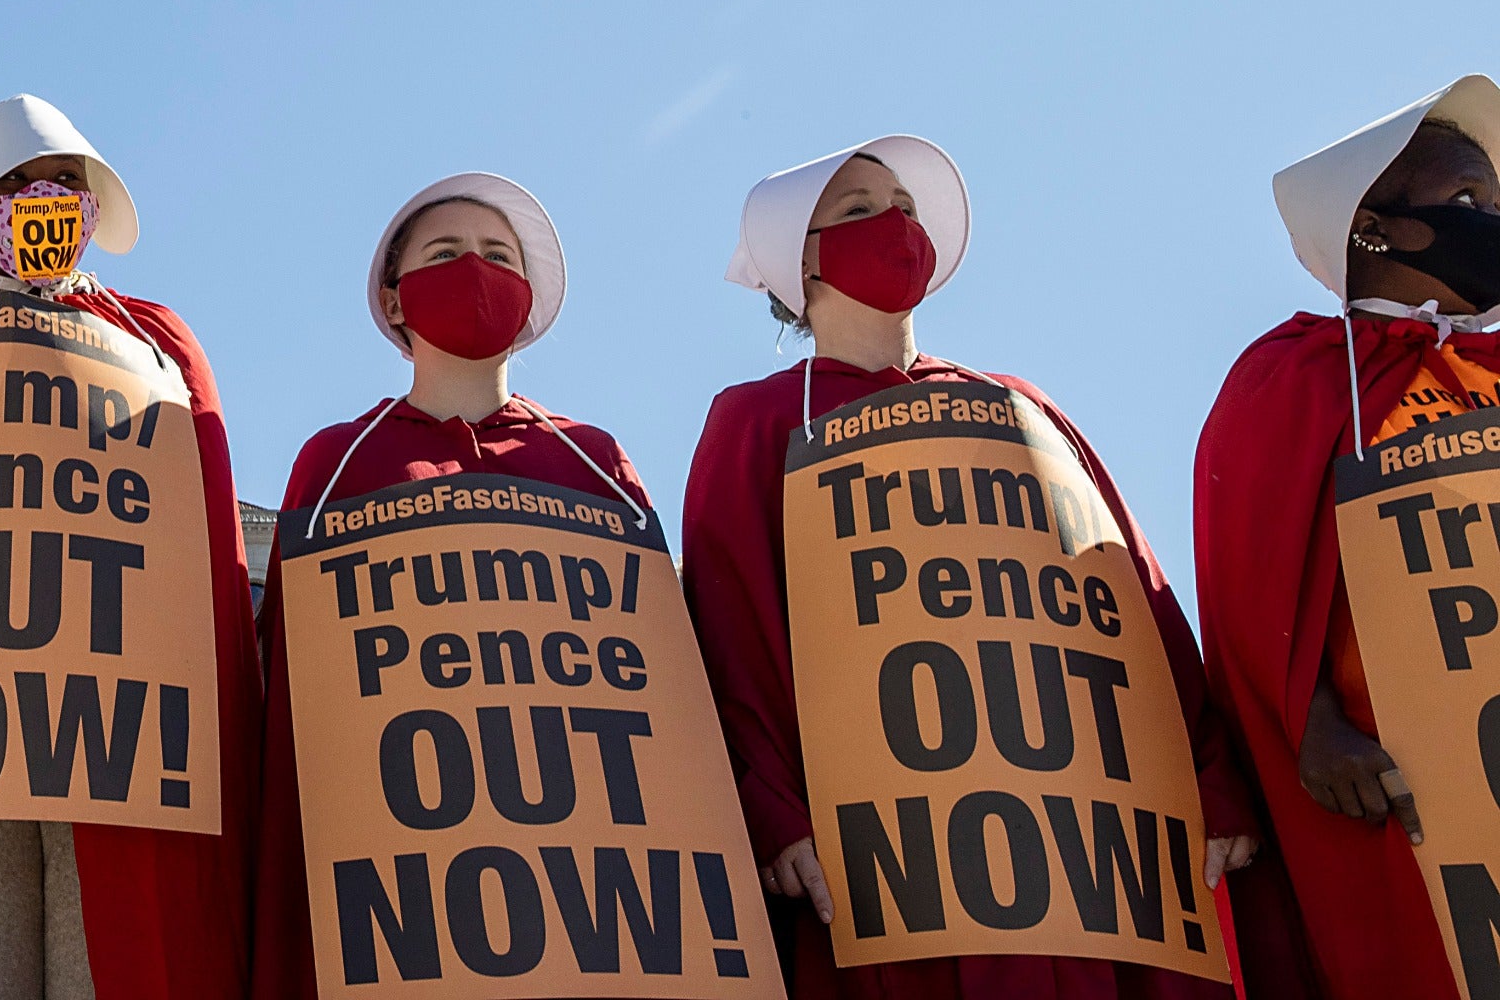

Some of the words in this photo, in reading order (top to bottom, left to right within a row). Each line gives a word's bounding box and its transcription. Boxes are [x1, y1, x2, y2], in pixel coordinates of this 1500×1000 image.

[19, 244, 78, 272] NOW
[22, 217, 77, 246] OUT
[324, 484, 626, 538] RefuseFascism.org
[319, 548, 641, 622] Trump/
[851, 546, 1122, 638] Pence
[353, 624, 649, 698] Pence
[878, 640, 1132, 783] OUT
[378, 705, 653, 831] OUT
[836, 790, 1208, 955] NOW!
[332, 845, 750, 986] NOW!
